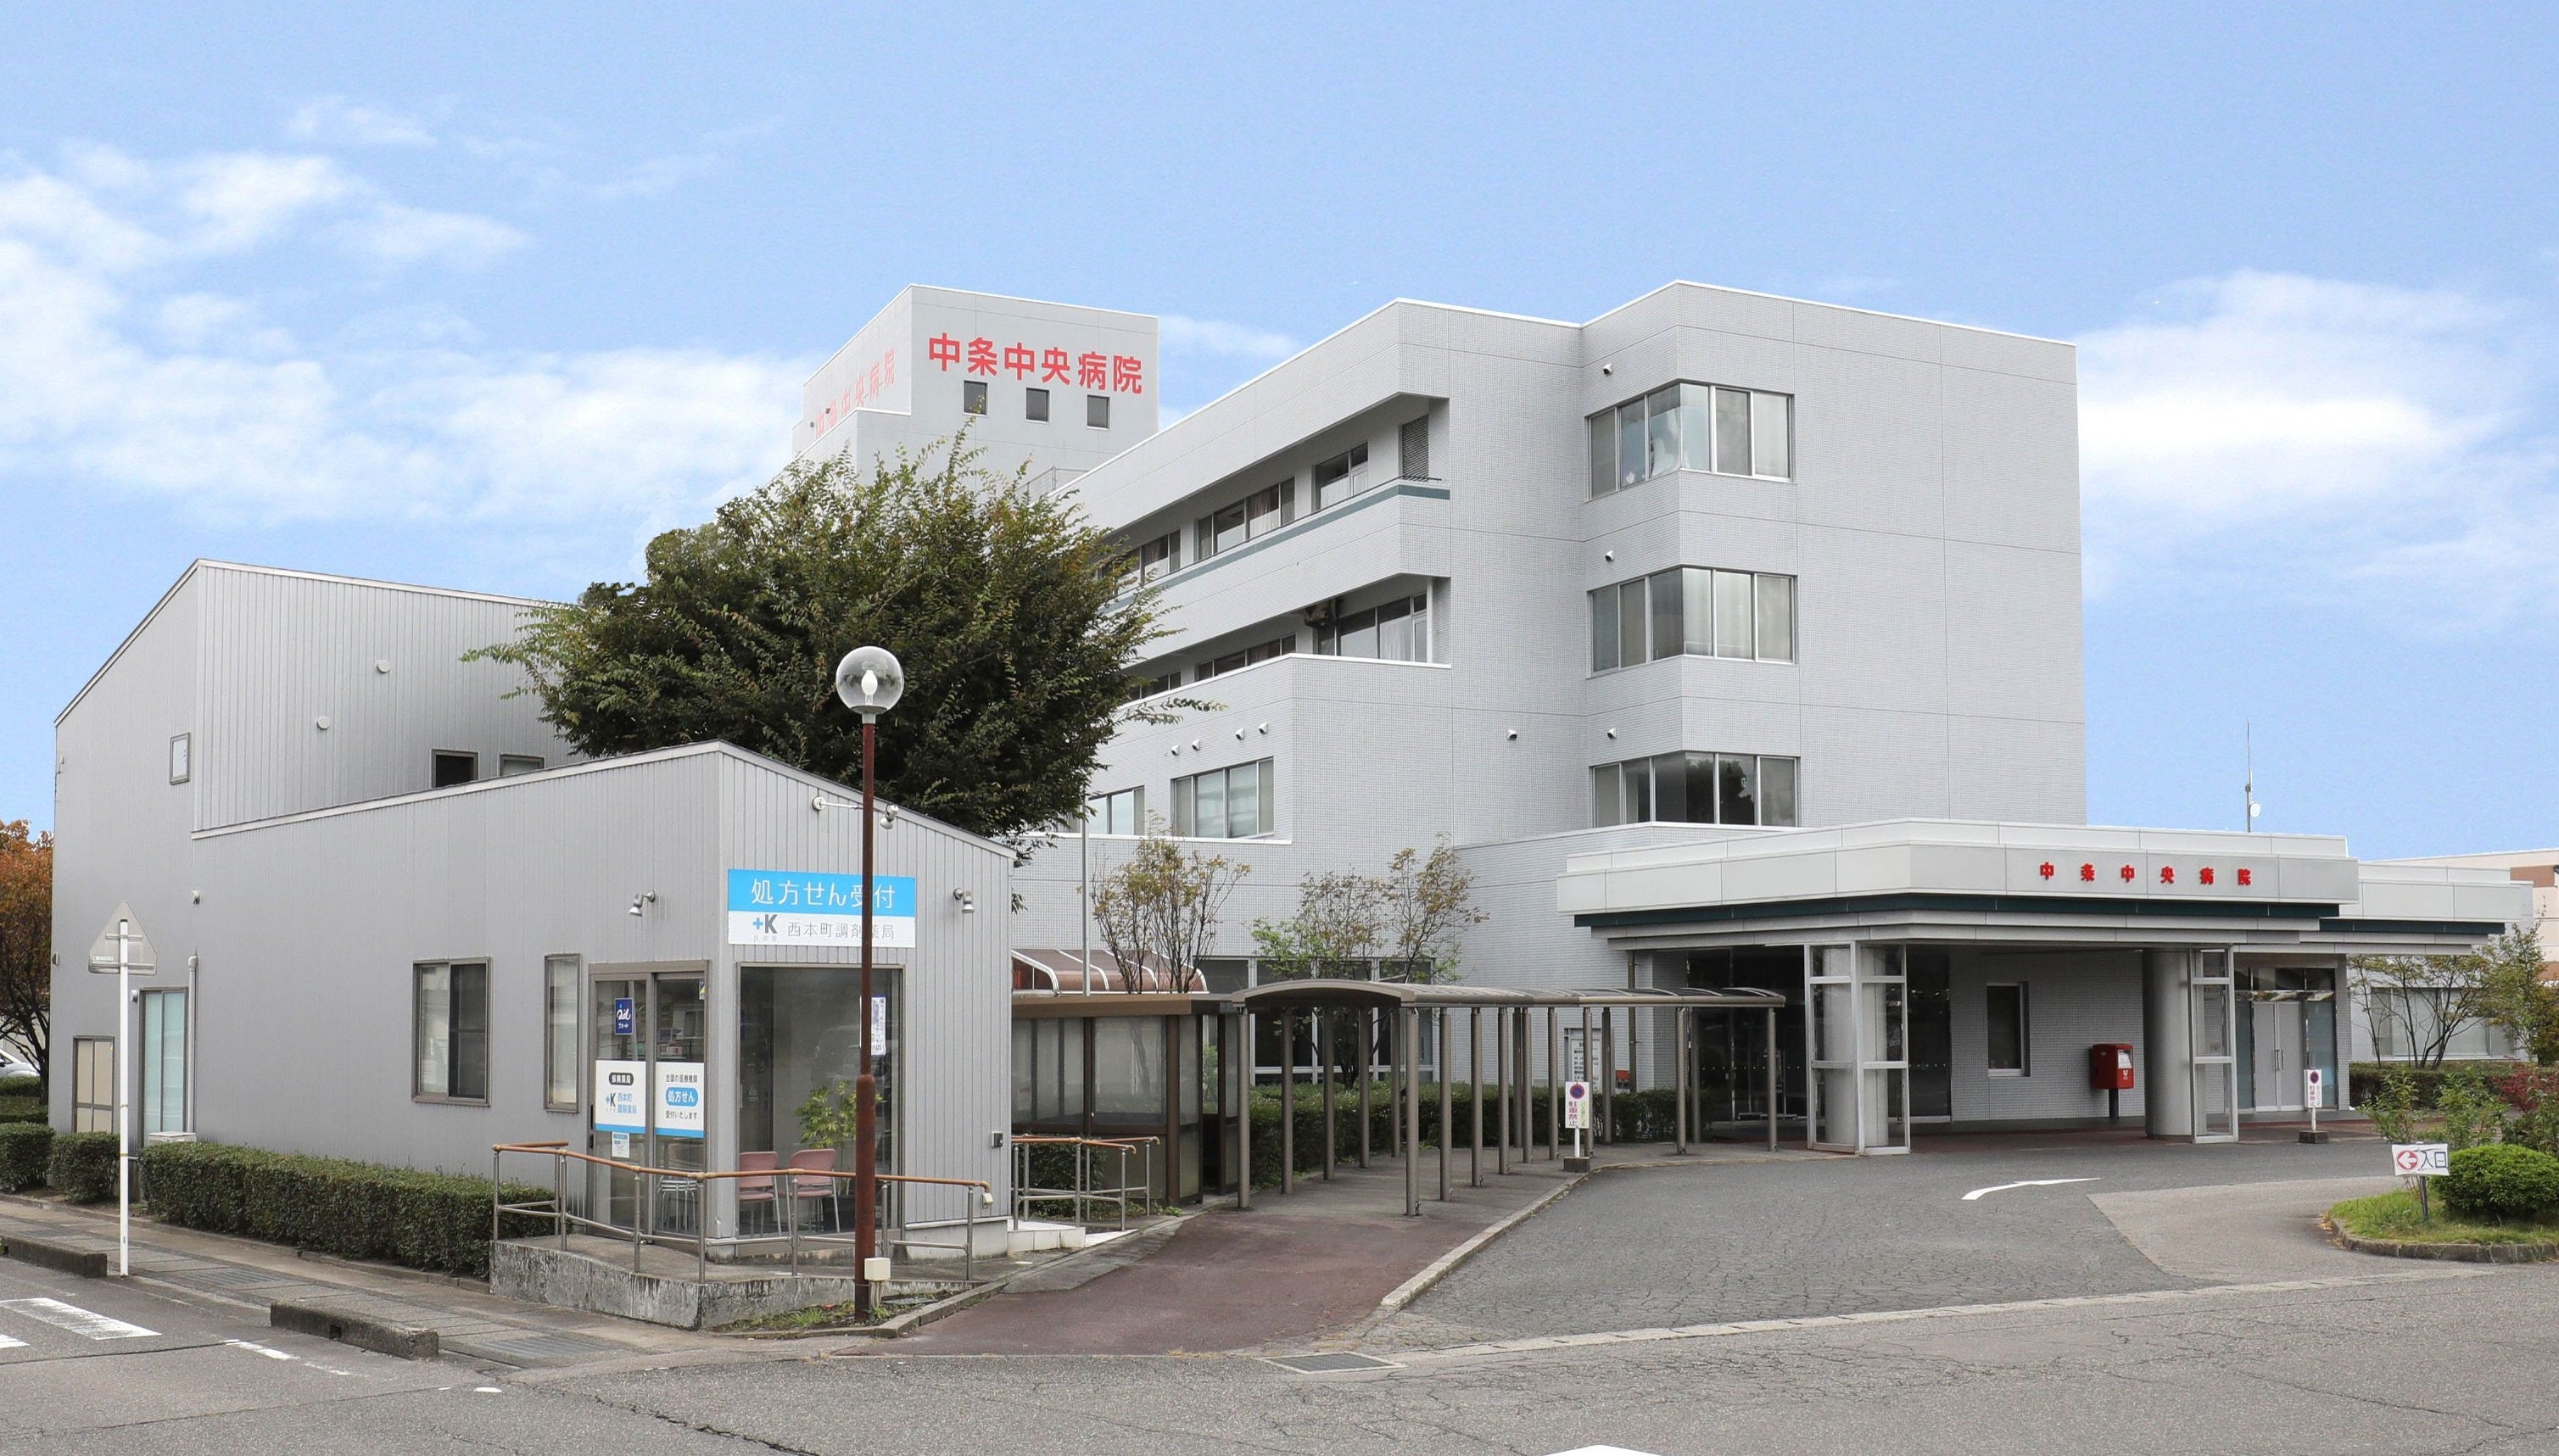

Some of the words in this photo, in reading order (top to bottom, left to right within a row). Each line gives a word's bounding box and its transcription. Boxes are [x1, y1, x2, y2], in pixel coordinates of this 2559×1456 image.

[929, 332, 1142, 394] 中条中央病院
[2039, 862, 2252, 885] 中条中央病院
[751, 878, 895, 909] 処方せん受付
